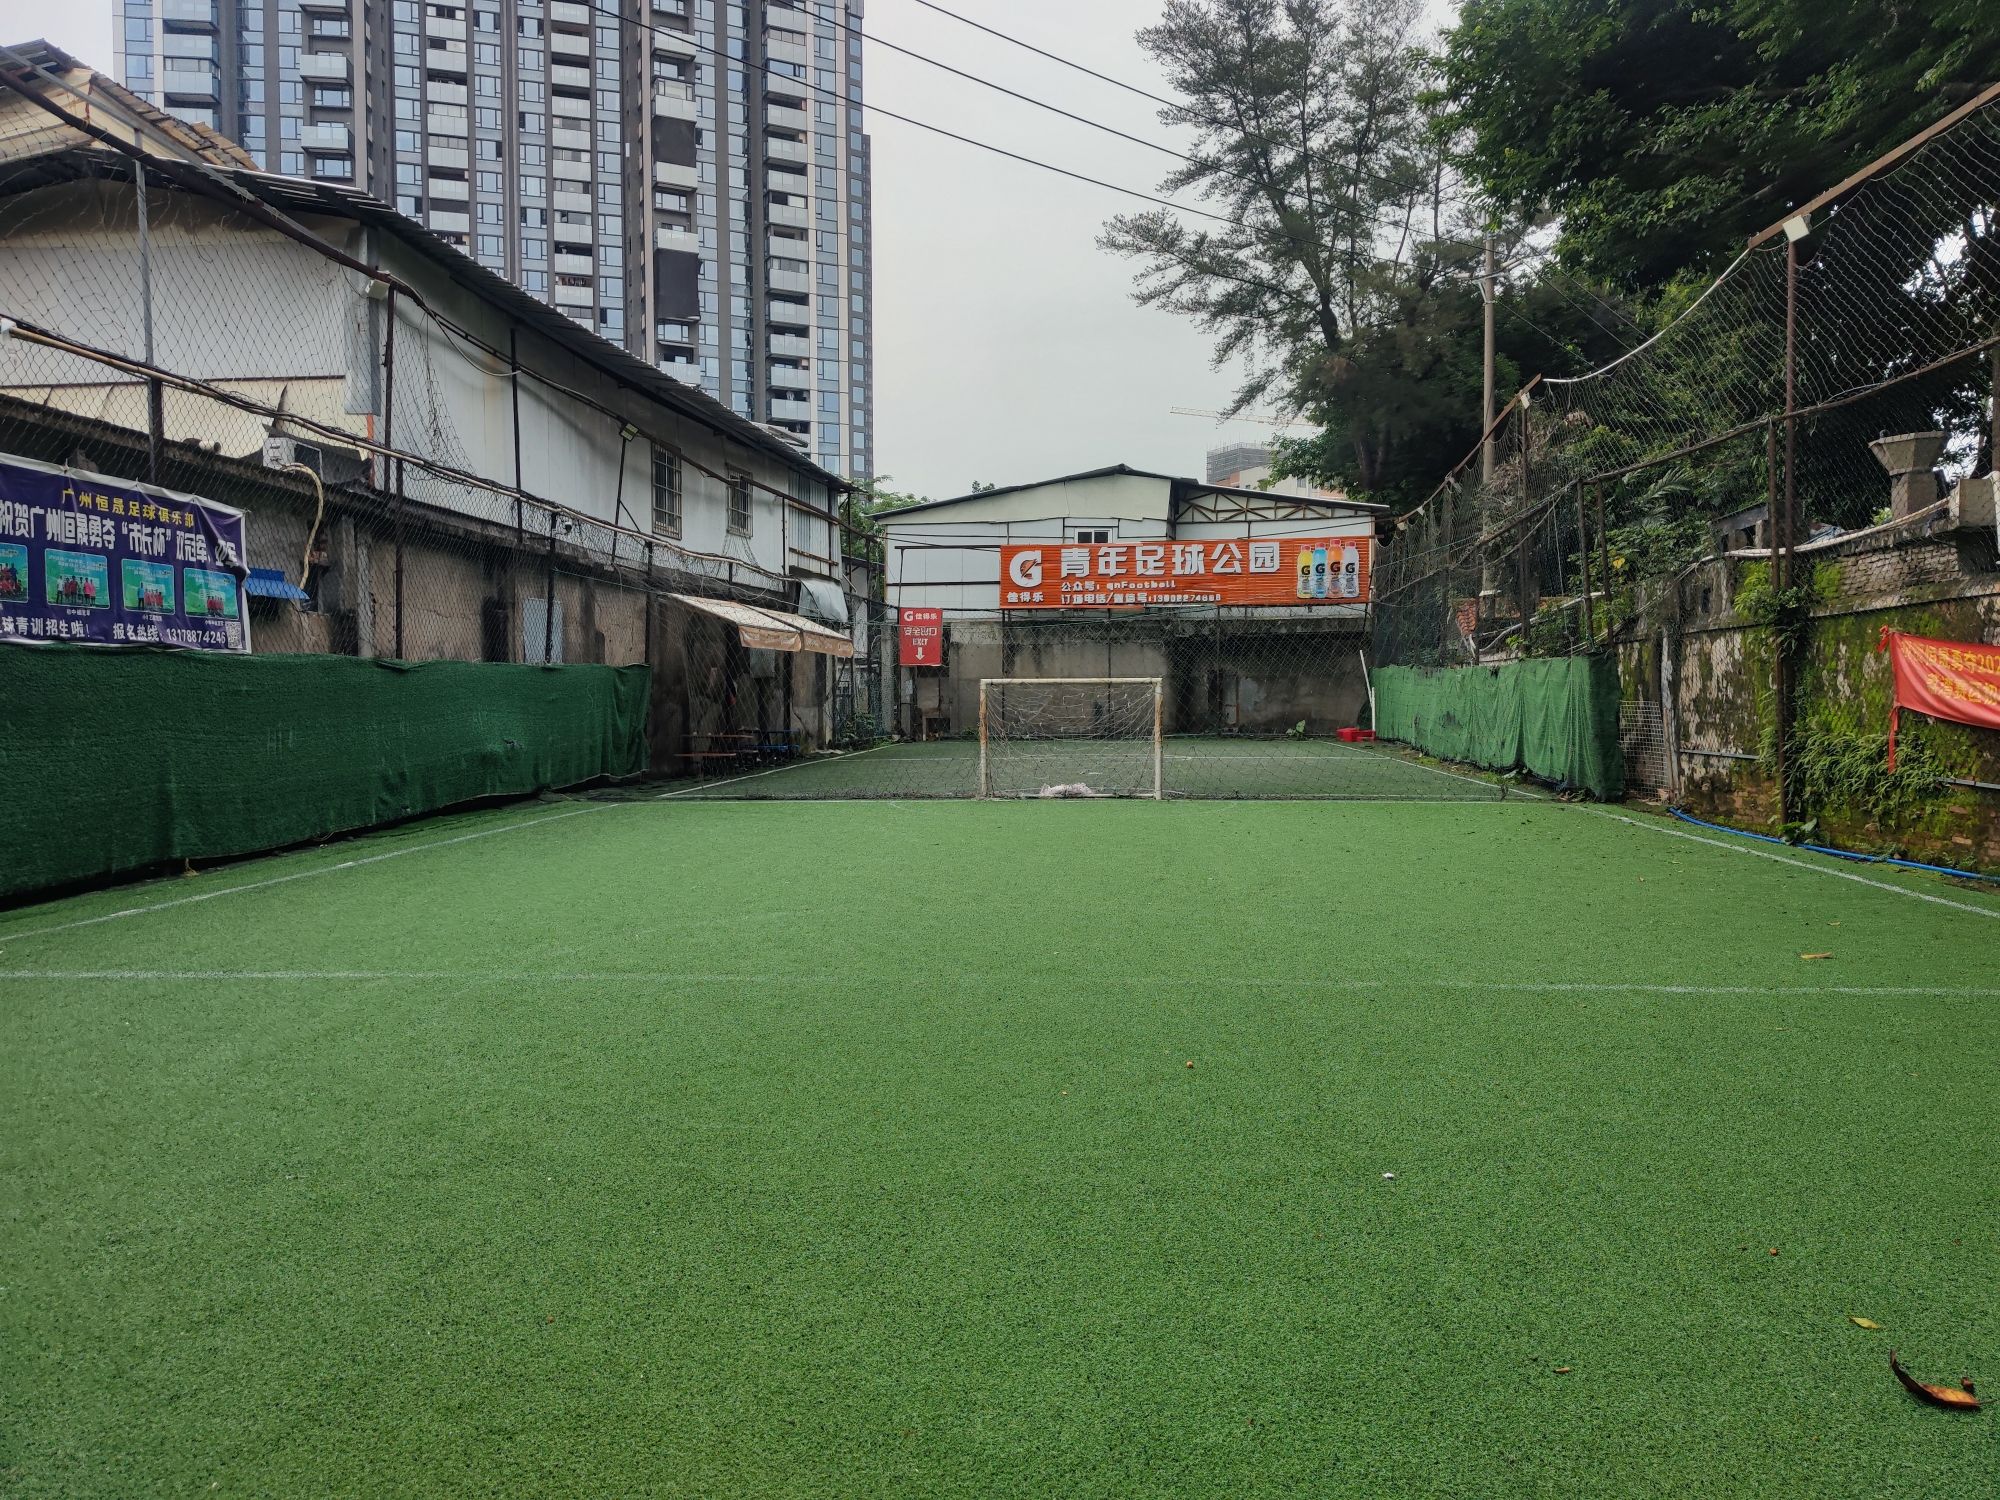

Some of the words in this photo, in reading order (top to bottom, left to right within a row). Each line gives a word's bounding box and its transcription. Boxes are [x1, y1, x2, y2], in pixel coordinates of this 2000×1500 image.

[62, 488, 194, 528] 广州恒晟足球俱乐部
[1009, 550, 1042, 588] G
[1060, 541, 1280, 577] 青年足球公园
[1007, 591, 1044, 603] 佳得乐
[0, 615, 90, 637] 球青训招生啦！
[904, 627, 937, 636] 安全出口
[912, 638, 928, 646] EXIT
